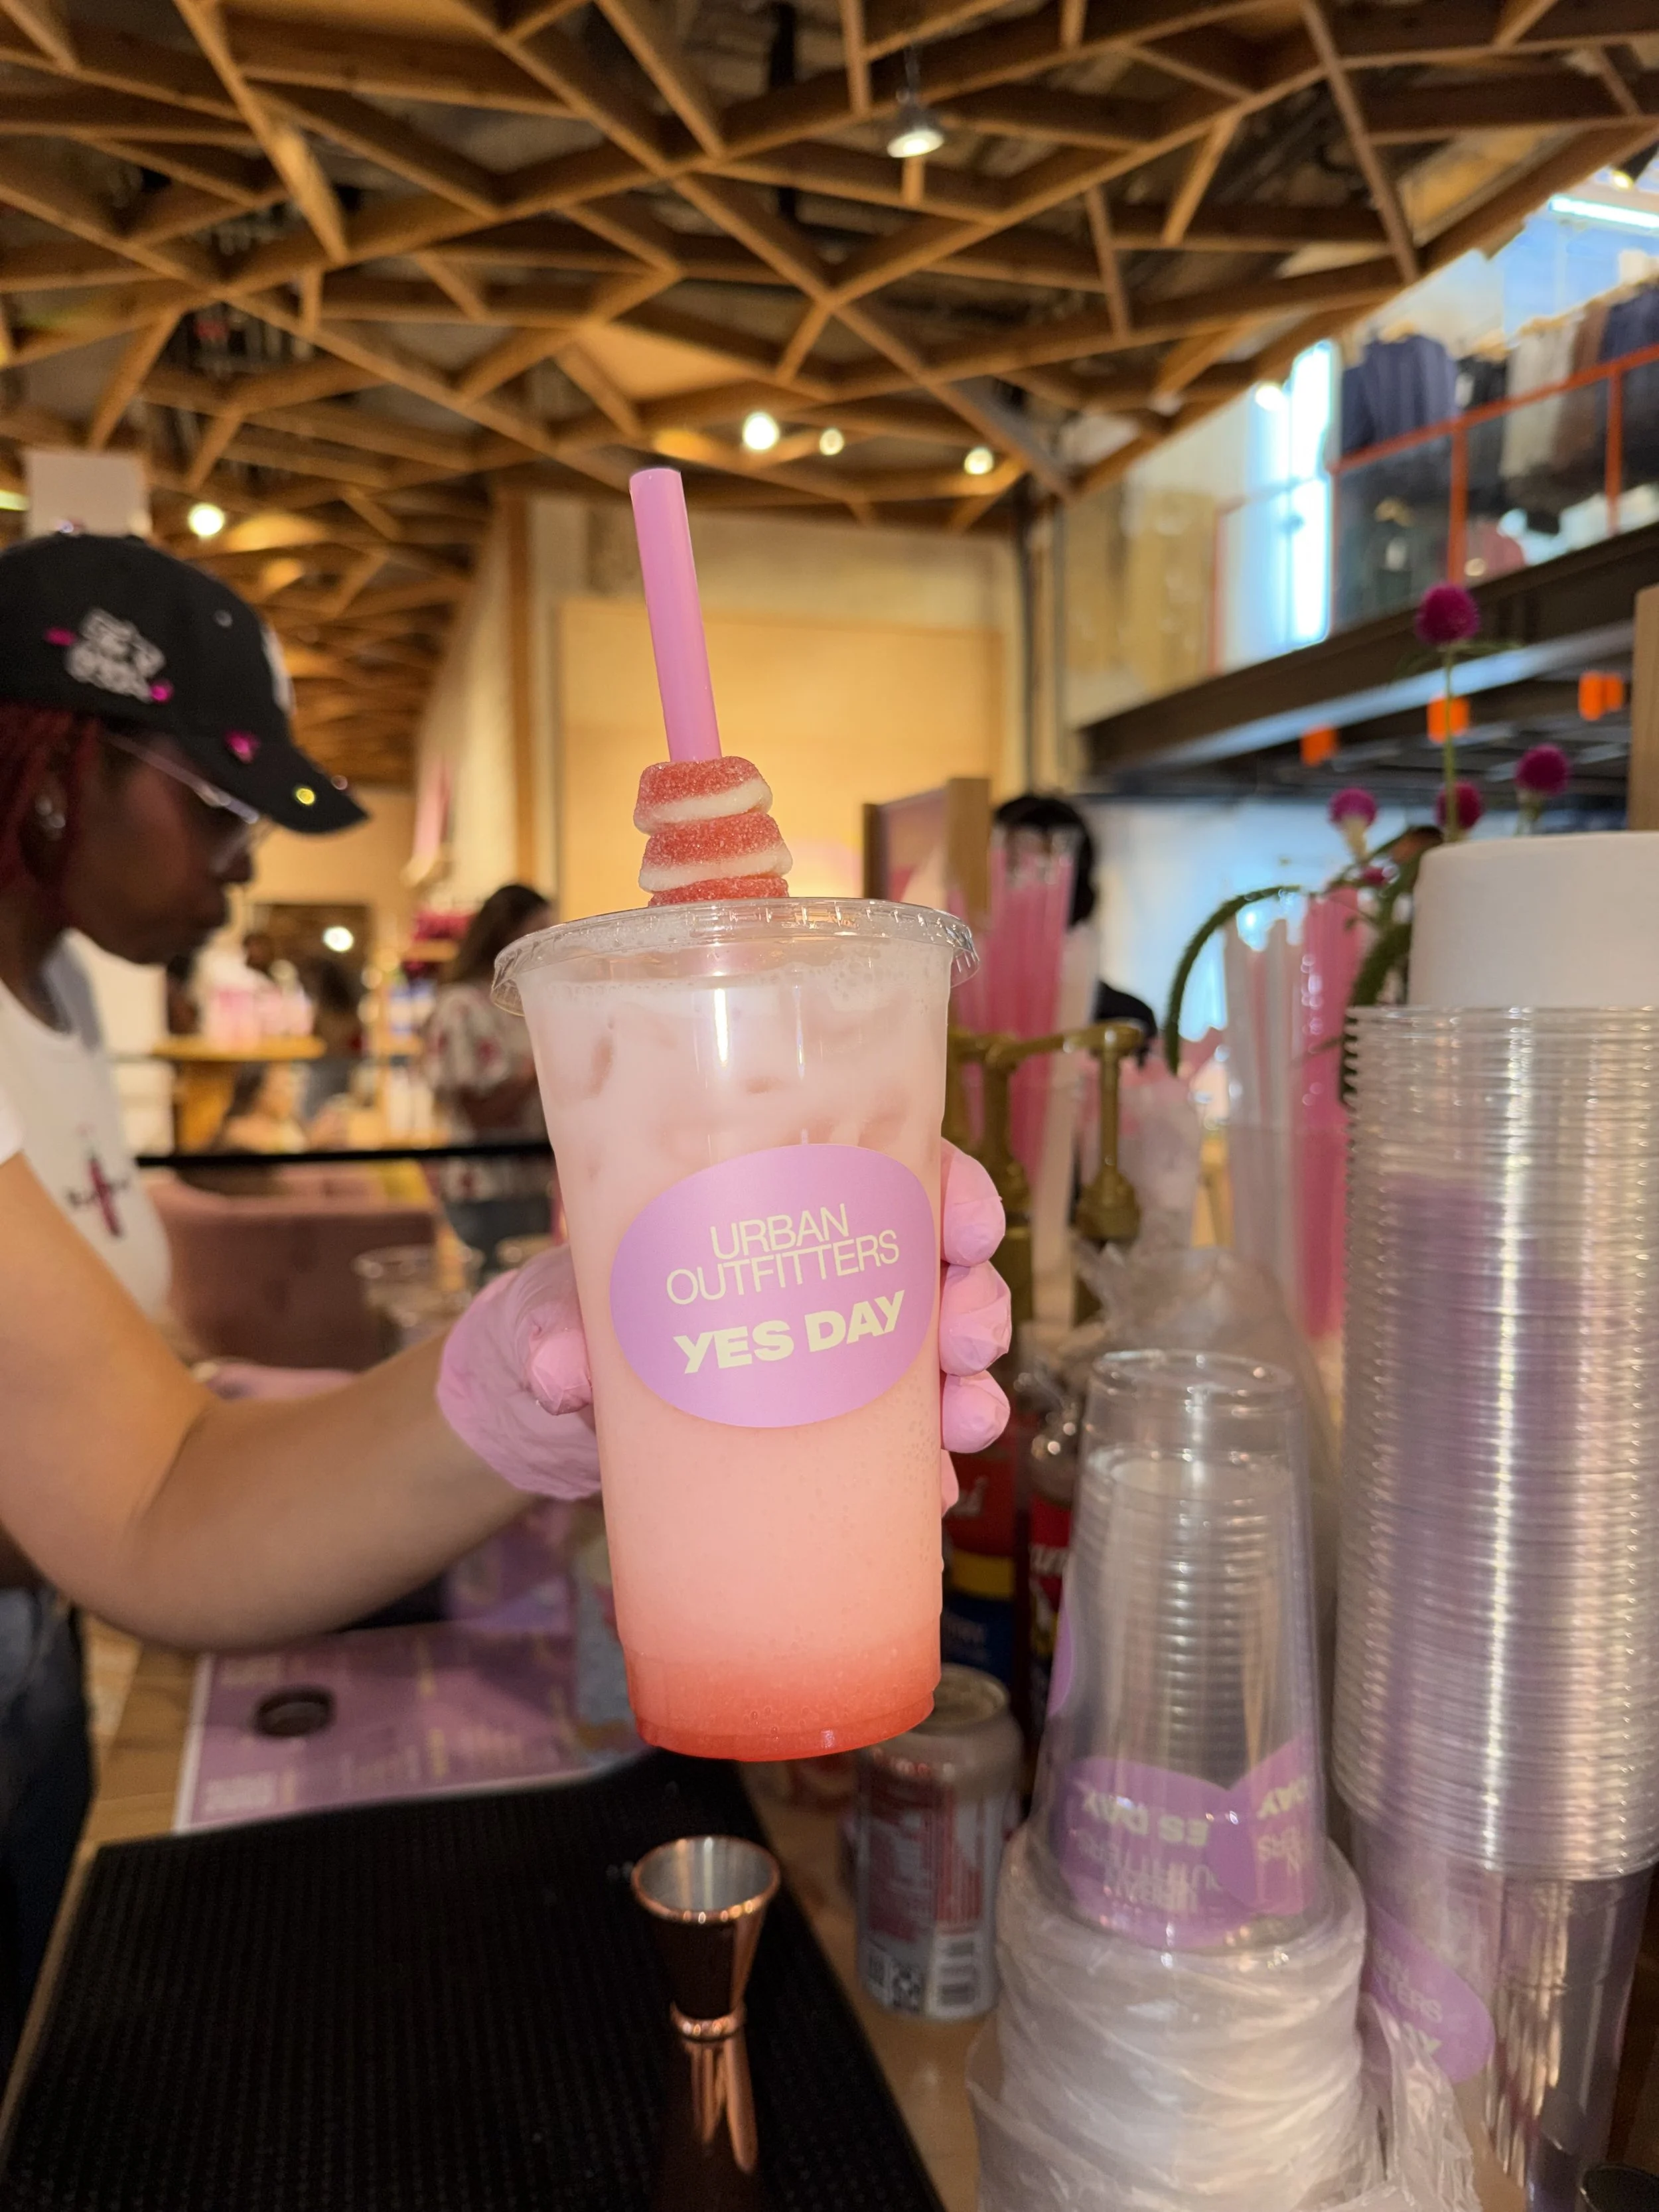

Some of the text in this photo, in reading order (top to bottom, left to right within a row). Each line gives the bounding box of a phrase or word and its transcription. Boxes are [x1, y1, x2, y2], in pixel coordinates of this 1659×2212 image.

[666, 1229, 900, 1305] OUTFITTERS
[709, 1203, 849, 1260] URBAN
[672, 1290, 905, 1374] YES DAY
